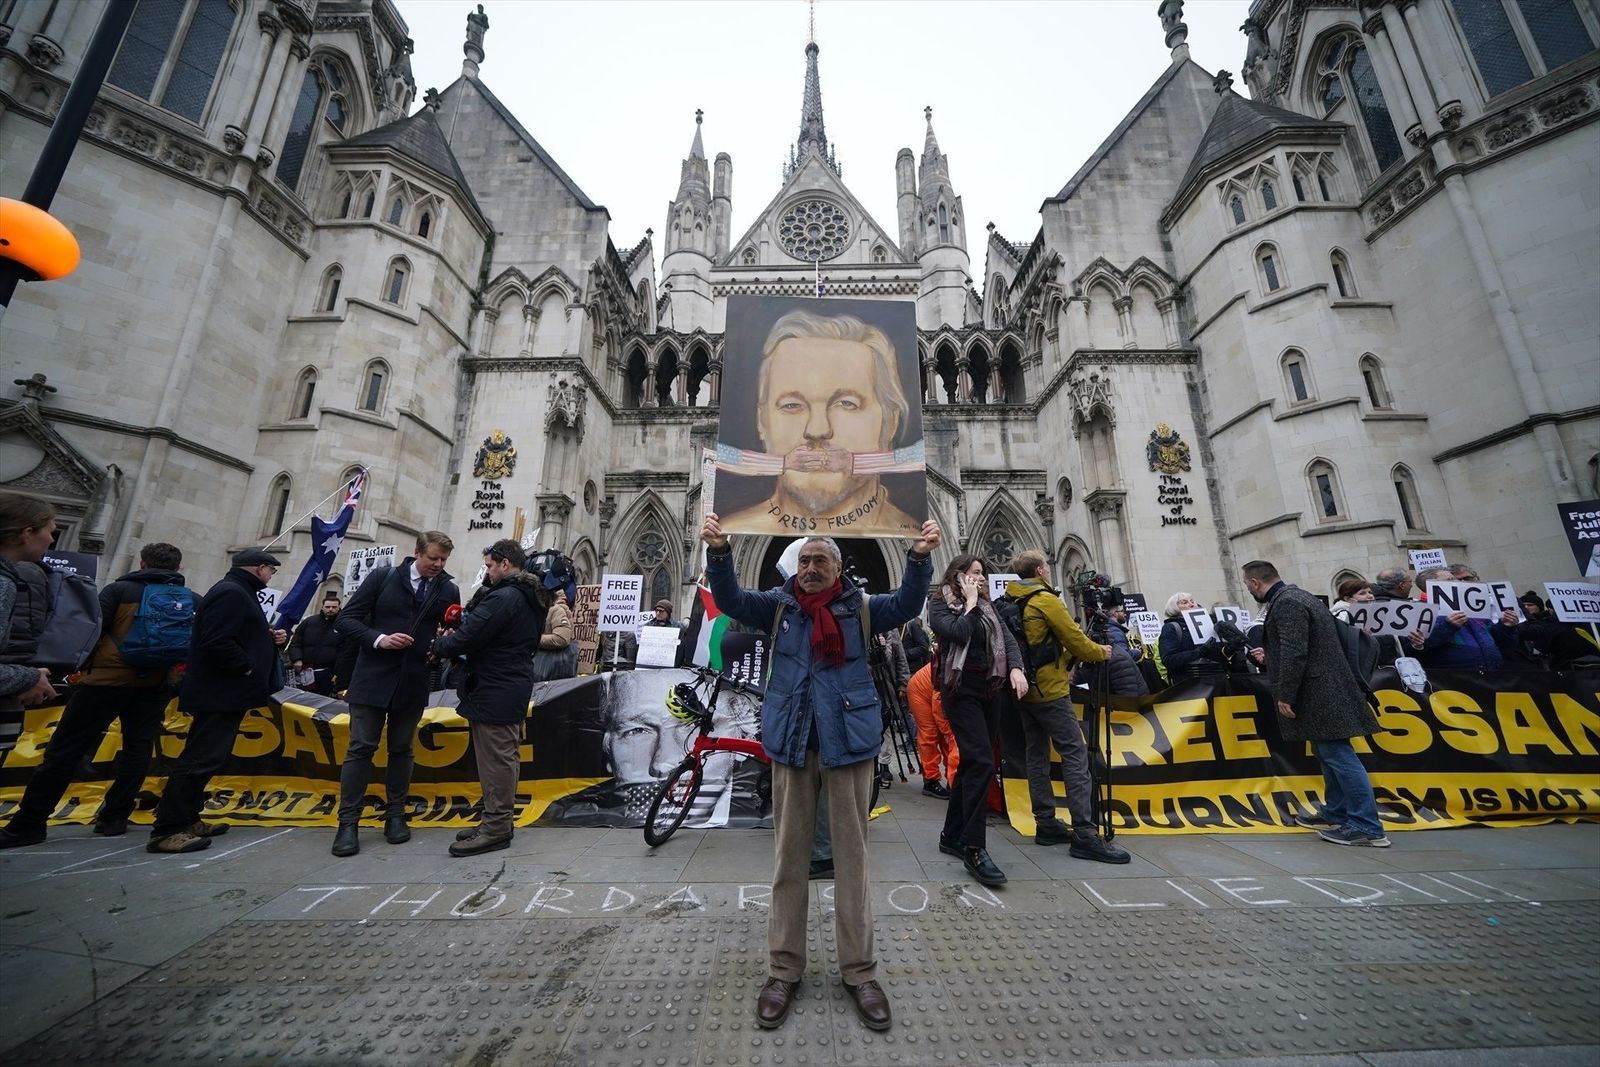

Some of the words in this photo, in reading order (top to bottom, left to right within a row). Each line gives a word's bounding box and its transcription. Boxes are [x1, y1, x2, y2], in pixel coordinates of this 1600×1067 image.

[1160, 475, 1182, 485] The
[481, 481, 502, 491] The
[1157, 485, 1189, 496] Royal
[475, 490, 504, 501] Royal
[1157, 495, 1194, 505] Courts
[471, 500, 506, 510] Courts
[1170, 505, 1183, 515] of
[480, 509, 494, 519] of
[767, 505, 817, 530] PRESS
[827, 496, 879, 529] FREEDOM
[467, 519, 504, 531] Justice
[1161, 515, 1198, 527] Justice
[350, 551, 365, 559] FREE
[364, 547, 394, 558] ASSANGE
[1415, 551, 1441, 560] FREE
[43, 556, 69, 565] Free
[607, 580, 638, 590] FREE
[257, 591, 275, 607] SA
[575, 587, 602, 603] SSANGE
[1560, 600, 1600, 613] LIED
[603, 614, 636, 625] NOW!
[1138, 613, 1159, 622] USA
[1188, 610, 1206, 639] F
[750, 640, 764, 687] Assange
[1306, 690, 1600, 756] SSAN
[234, 791, 312, 813] NOT
[307, 793, 339, 815] A
[1459, 787, 1502, 811] IS
[1506, 788, 1589, 811] NOT
